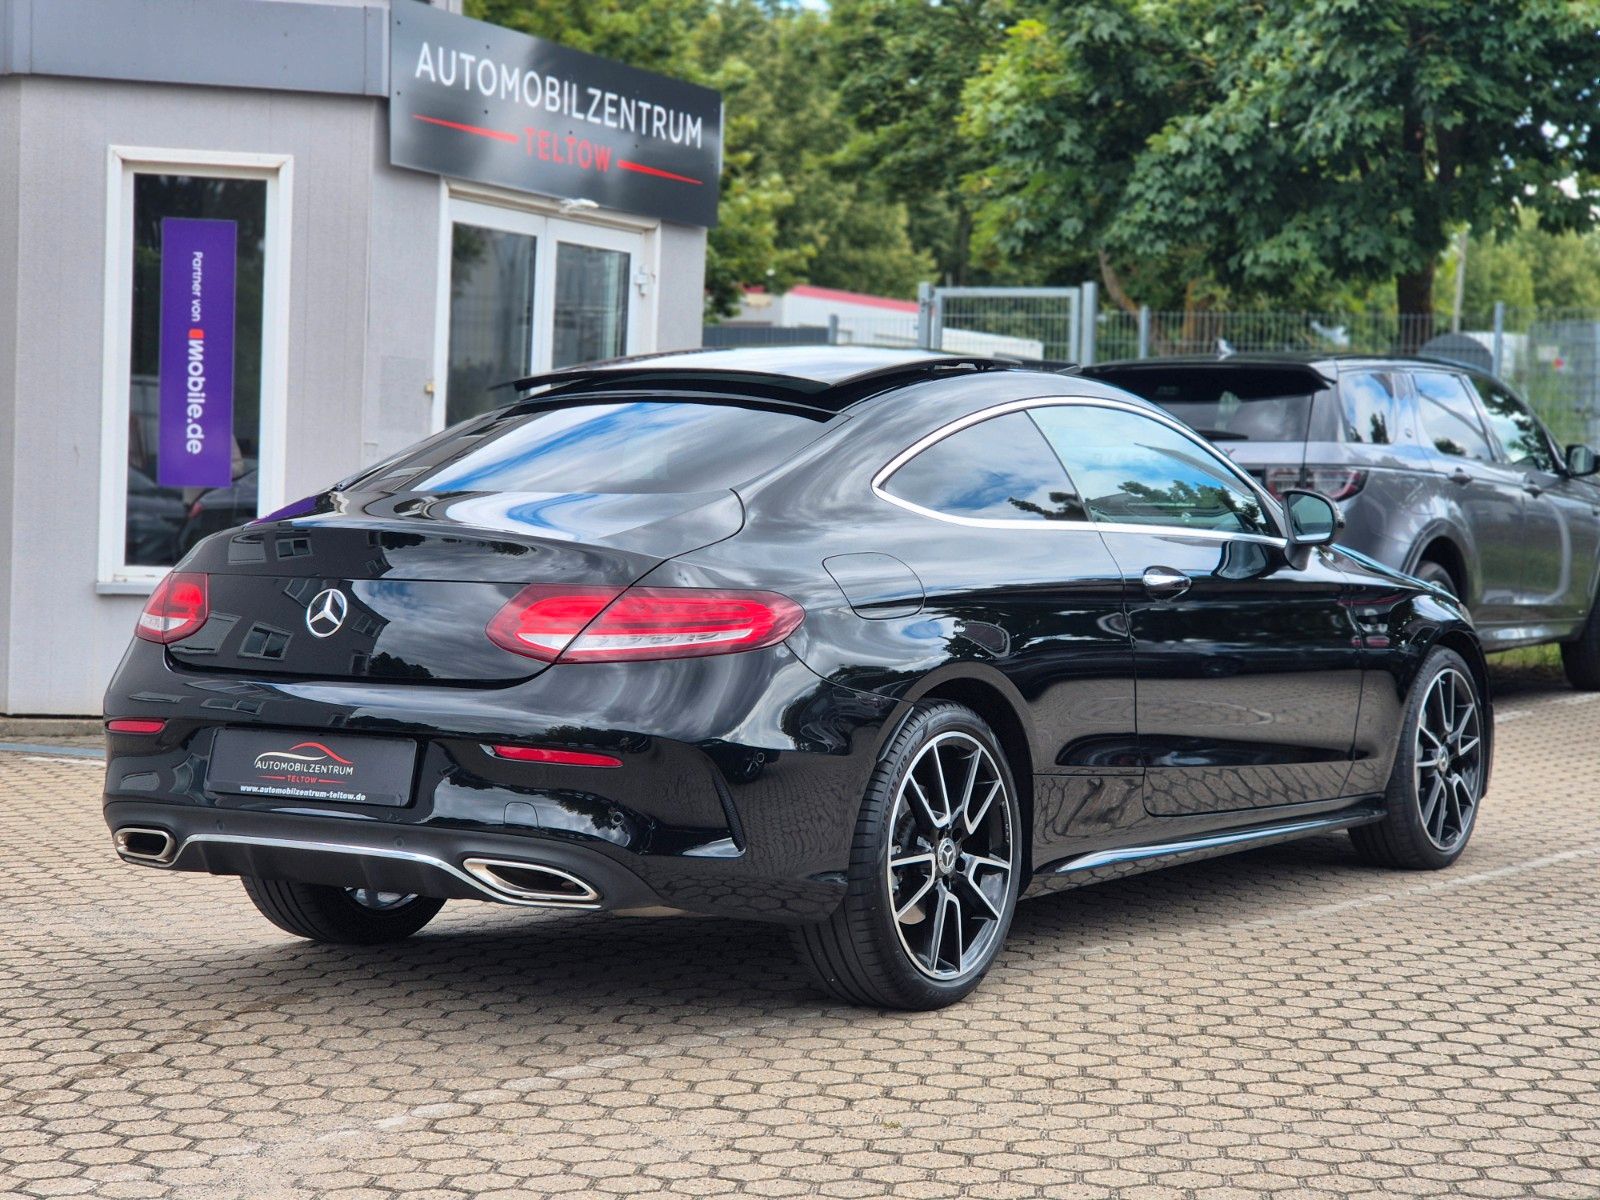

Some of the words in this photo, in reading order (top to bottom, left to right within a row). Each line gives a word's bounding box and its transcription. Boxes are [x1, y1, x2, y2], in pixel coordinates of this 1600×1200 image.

[415, 42, 702, 148] AUTOMOBILZENTRUM
[523, 127, 612, 172] TELTOW
[191, 251, 204, 297] Partner
[191, 299, 202, 322] von
[186, 339, 206, 454] mobile.de
[255, 760, 354, 776] AUTOMOBILZENTRUM
[287, 775, 317, 784] TELTOW
[240, 784, 366, 801] www.automobilzentrum-teltow.de
